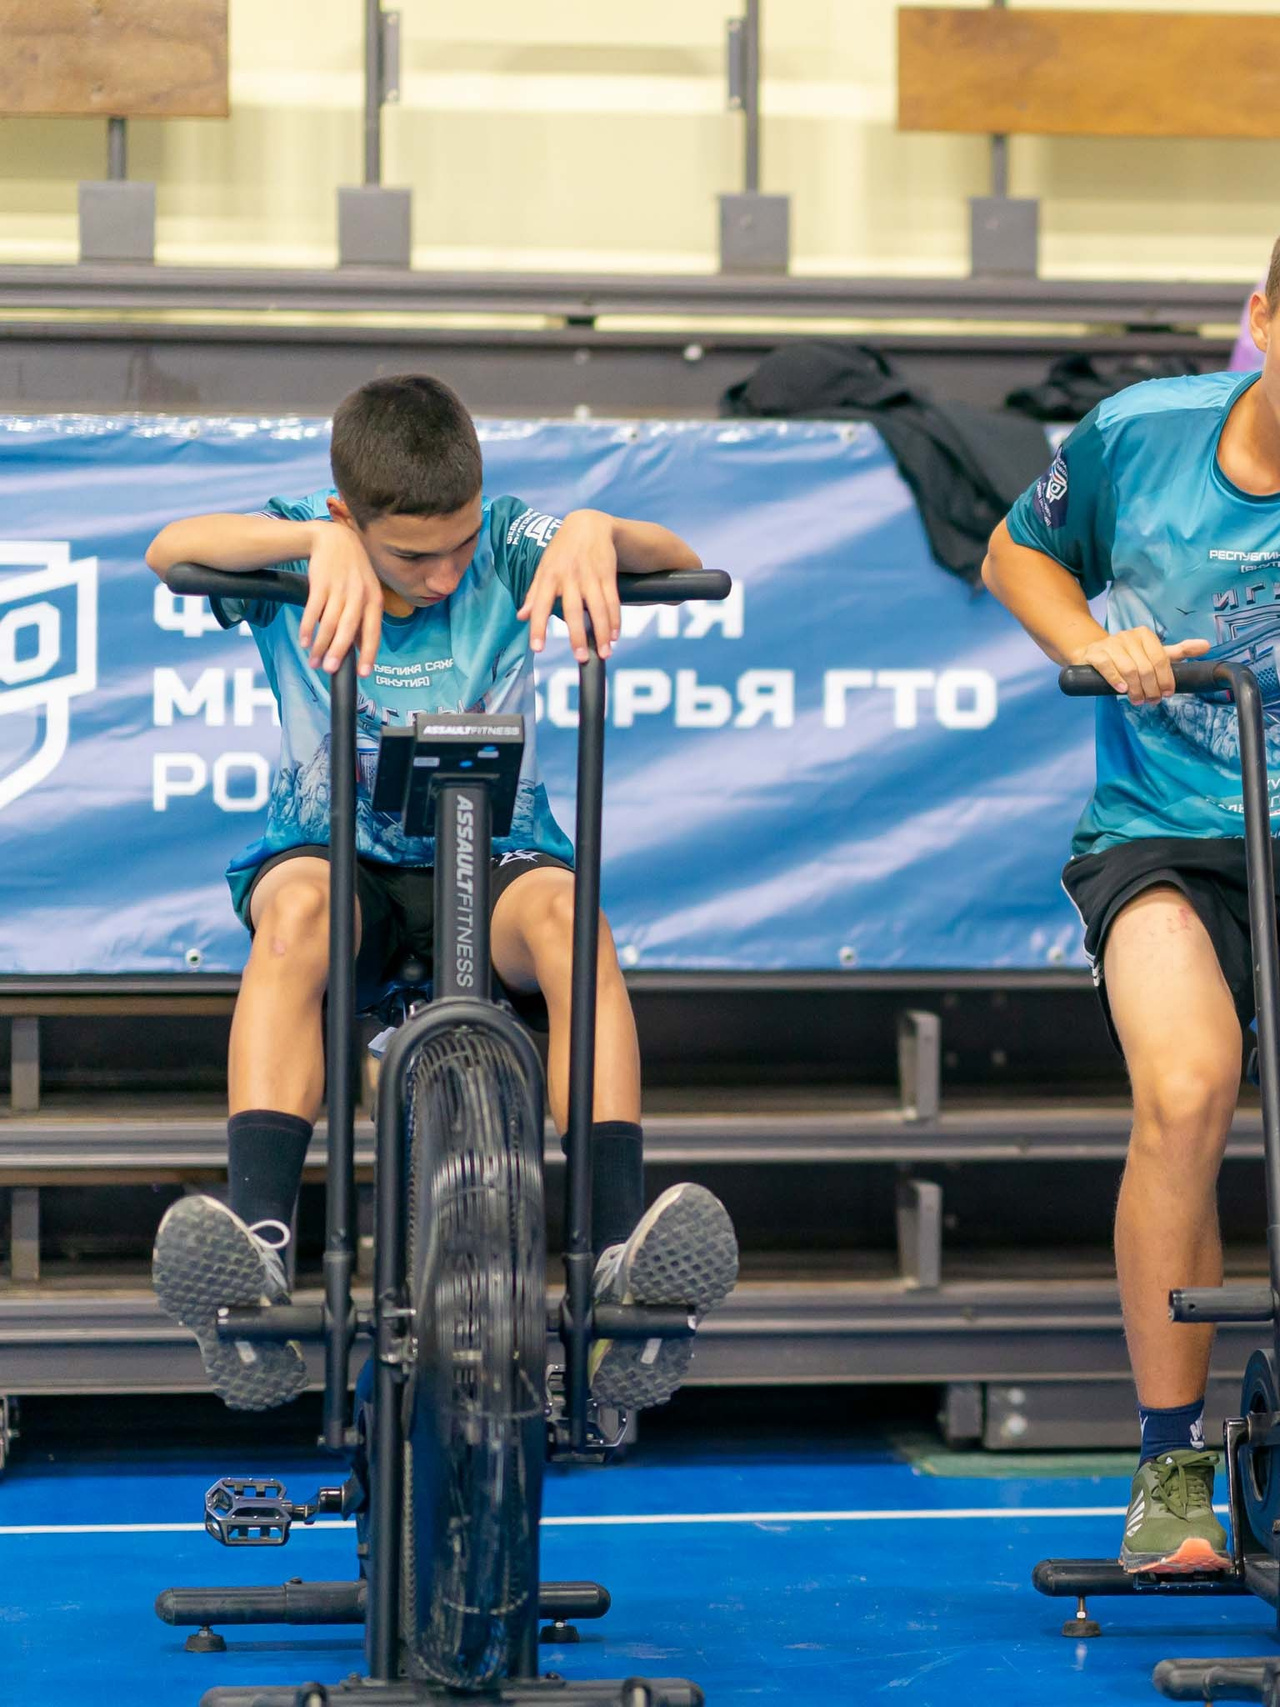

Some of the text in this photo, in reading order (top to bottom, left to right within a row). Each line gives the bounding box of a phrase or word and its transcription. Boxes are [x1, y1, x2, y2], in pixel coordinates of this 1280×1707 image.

[373, 663, 422, 677] УБЛИКА
[824, 668, 998, 729] ГТО
[456, 795, 474, 988] ASSAULTFITNESS
